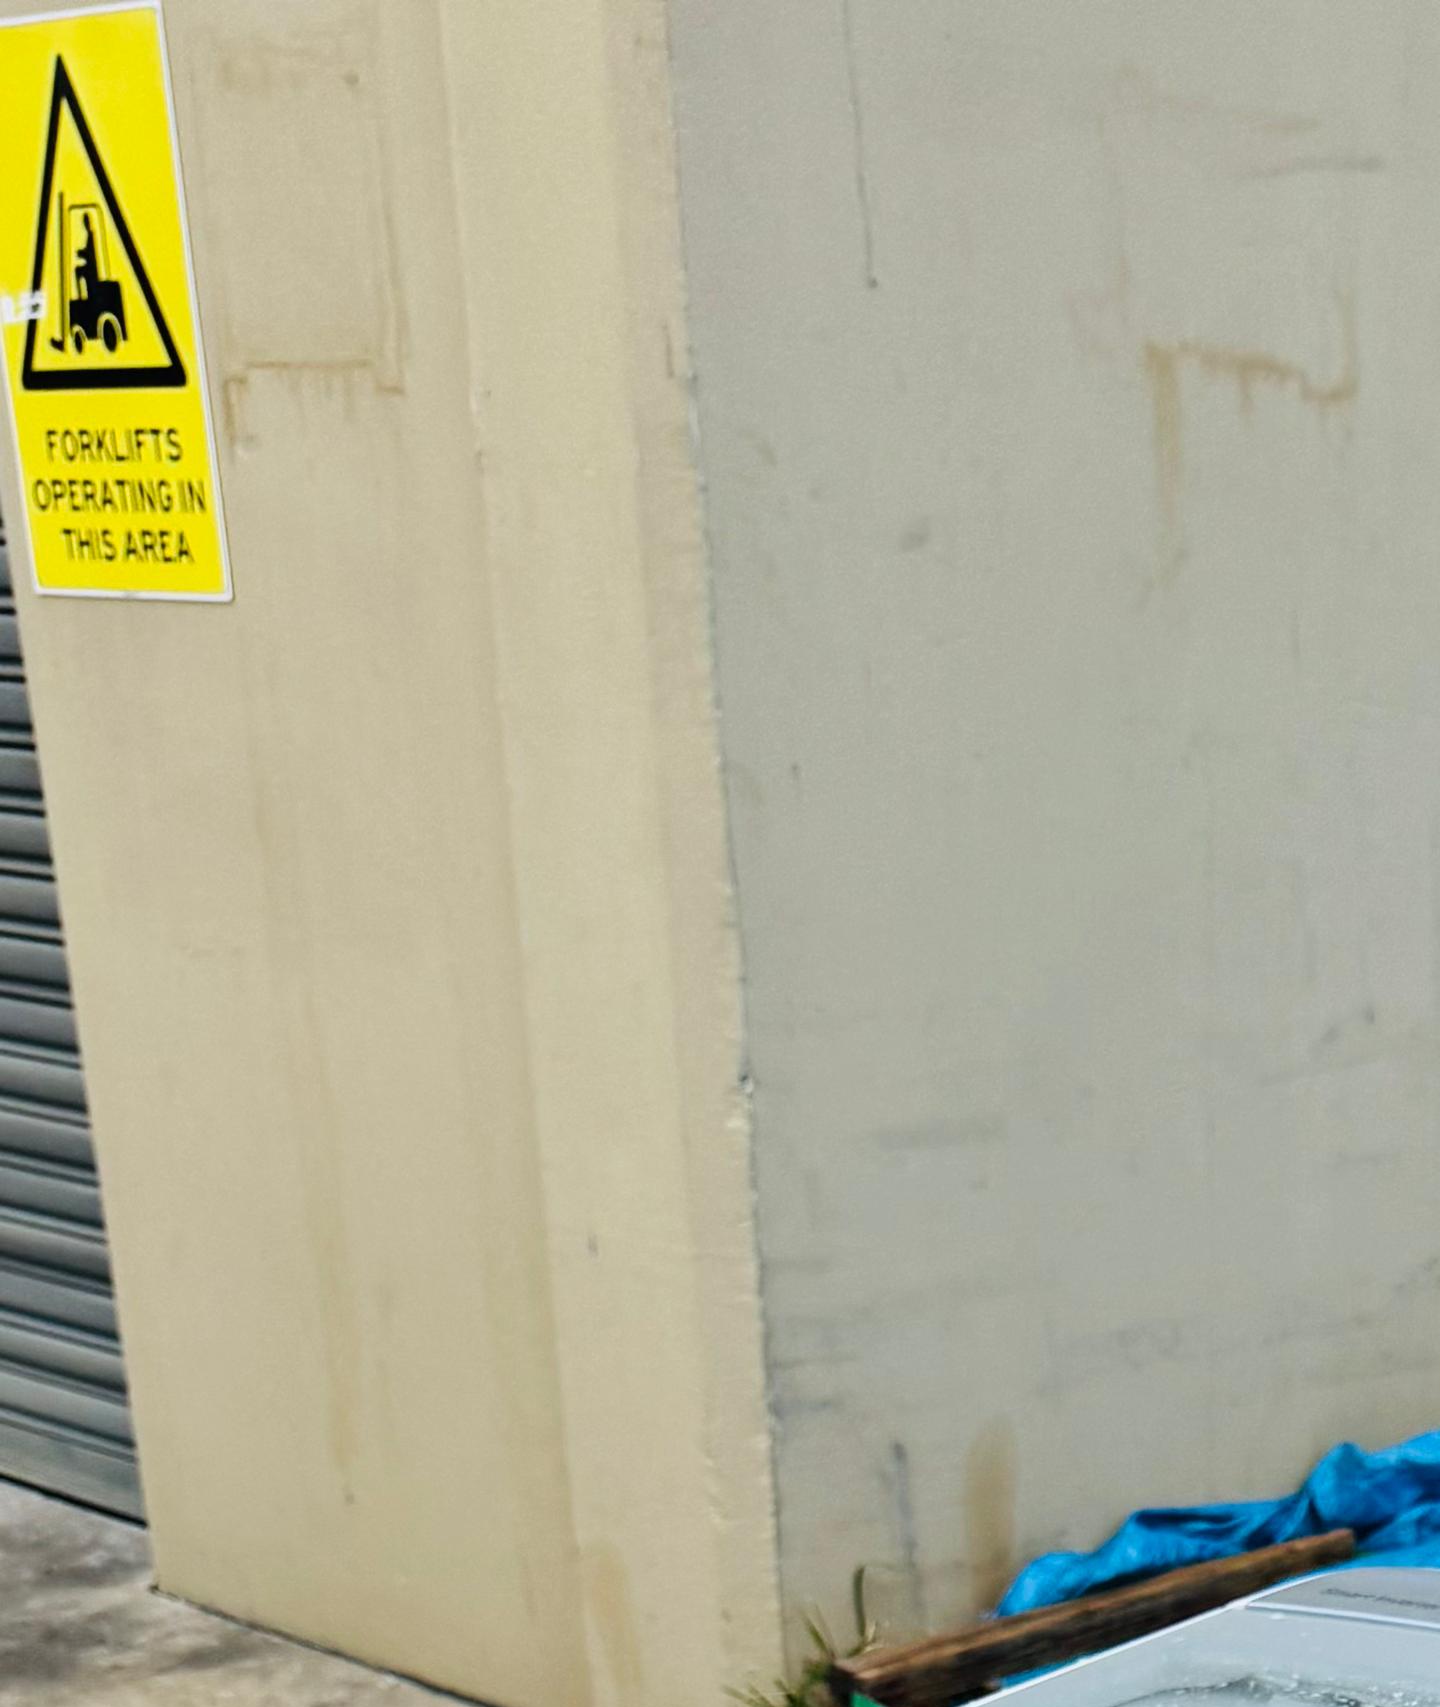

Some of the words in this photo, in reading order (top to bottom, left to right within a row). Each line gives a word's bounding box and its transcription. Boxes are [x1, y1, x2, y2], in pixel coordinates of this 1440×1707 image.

[46, 428, 183, 462] FORKLIFTS
[33, 479, 173, 512] OPERATING
[178, 479, 206, 512] IN
[62, 528, 116, 561] THIS
[126, 530, 195, 563] AREA
